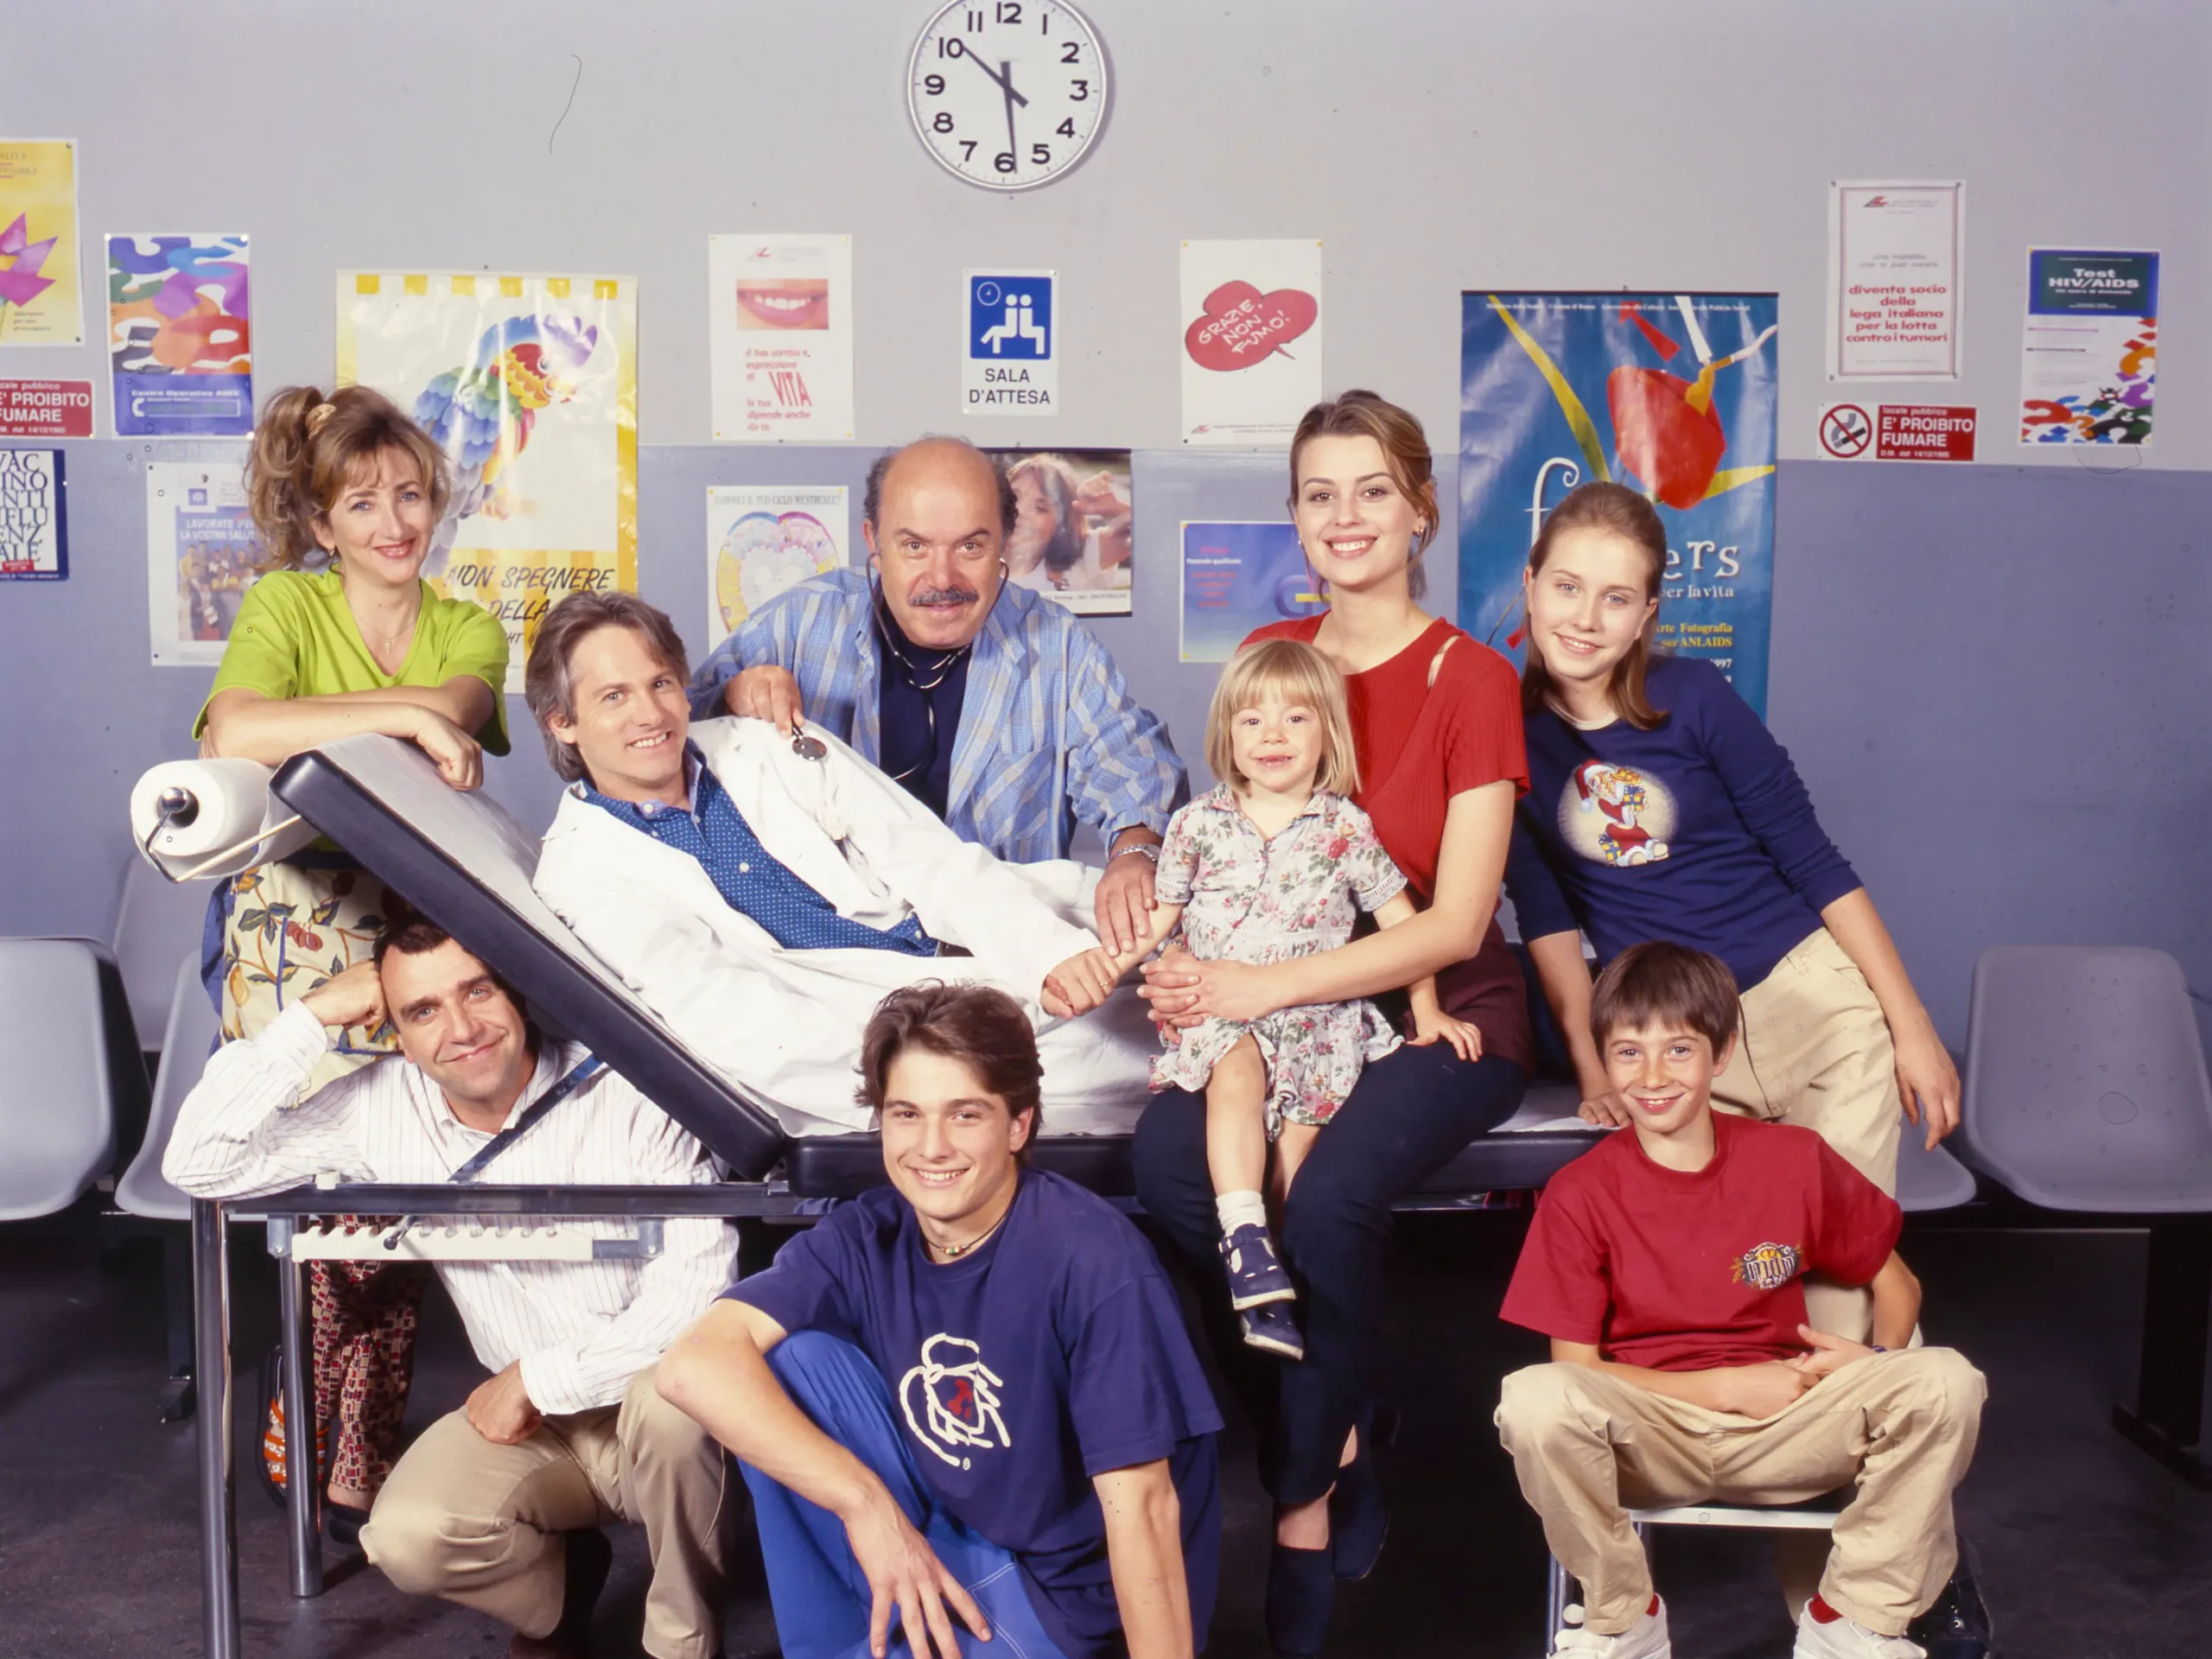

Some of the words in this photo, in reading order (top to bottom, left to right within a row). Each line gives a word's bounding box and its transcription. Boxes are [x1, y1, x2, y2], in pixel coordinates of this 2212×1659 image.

[967, 10, 983, 33] 11
[996, 2, 1022, 24] 12
[1041, 13, 1049, 35] 1
[938, 37, 963, 59] 10
[1059, 41, 1080, 64] 2
[924, 74, 945, 96] 9
[1068, 79, 1089, 101] 3
[932, 111, 954, 133] 8
[1056, 117, 1076, 138] 4
[958, 140, 978, 162] 7
[1031, 143, 1052, 165] 5
[994, 152, 1016, 174] 6
[2073, 268, 2116, 278] Test
[1848, 285, 1906, 295] diventa
[1910, 283, 1947, 295] socio
[2049, 277, 2140, 289] HIV/AIDS
[1879, 296, 1916, 306] della
[1849, 308, 1882, 320] lega
[1887, 308, 1944, 318] italiana
[1221, 314, 1262, 346] NON
[1855, 322, 1882, 333] per
[1885, 321, 1898, 330] la
[1901, 320, 1937, 330] lotta
[1846, 333, 1892, 343] contro
[1898, 332, 1948, 343] tumori
[984, 367, 1031, 383] SALA
[768, 371, 812, 407] VITA
[969, 389, 1052, 405] D'ATTESA
[11, 391, 90, 407] PROIBITO
[1910, 407, 1948, 417] pubblico
[1882, 416, 1897, 430] E'
[1900, 417, 1974, 433] PROIBITO
[1881, 432, 1948, 447] FUMARE
[187, 518, 234, 529] LAVORATE
[193, 530, 227, 540] VOSTRA
[500, 565, 615, 594] SPEGNERE
[487, 598, 550, 621] DELLA
[1679, 622, 1733, 634] Fotografia
[1681, 637, 1732, 646] ANLAIDS
